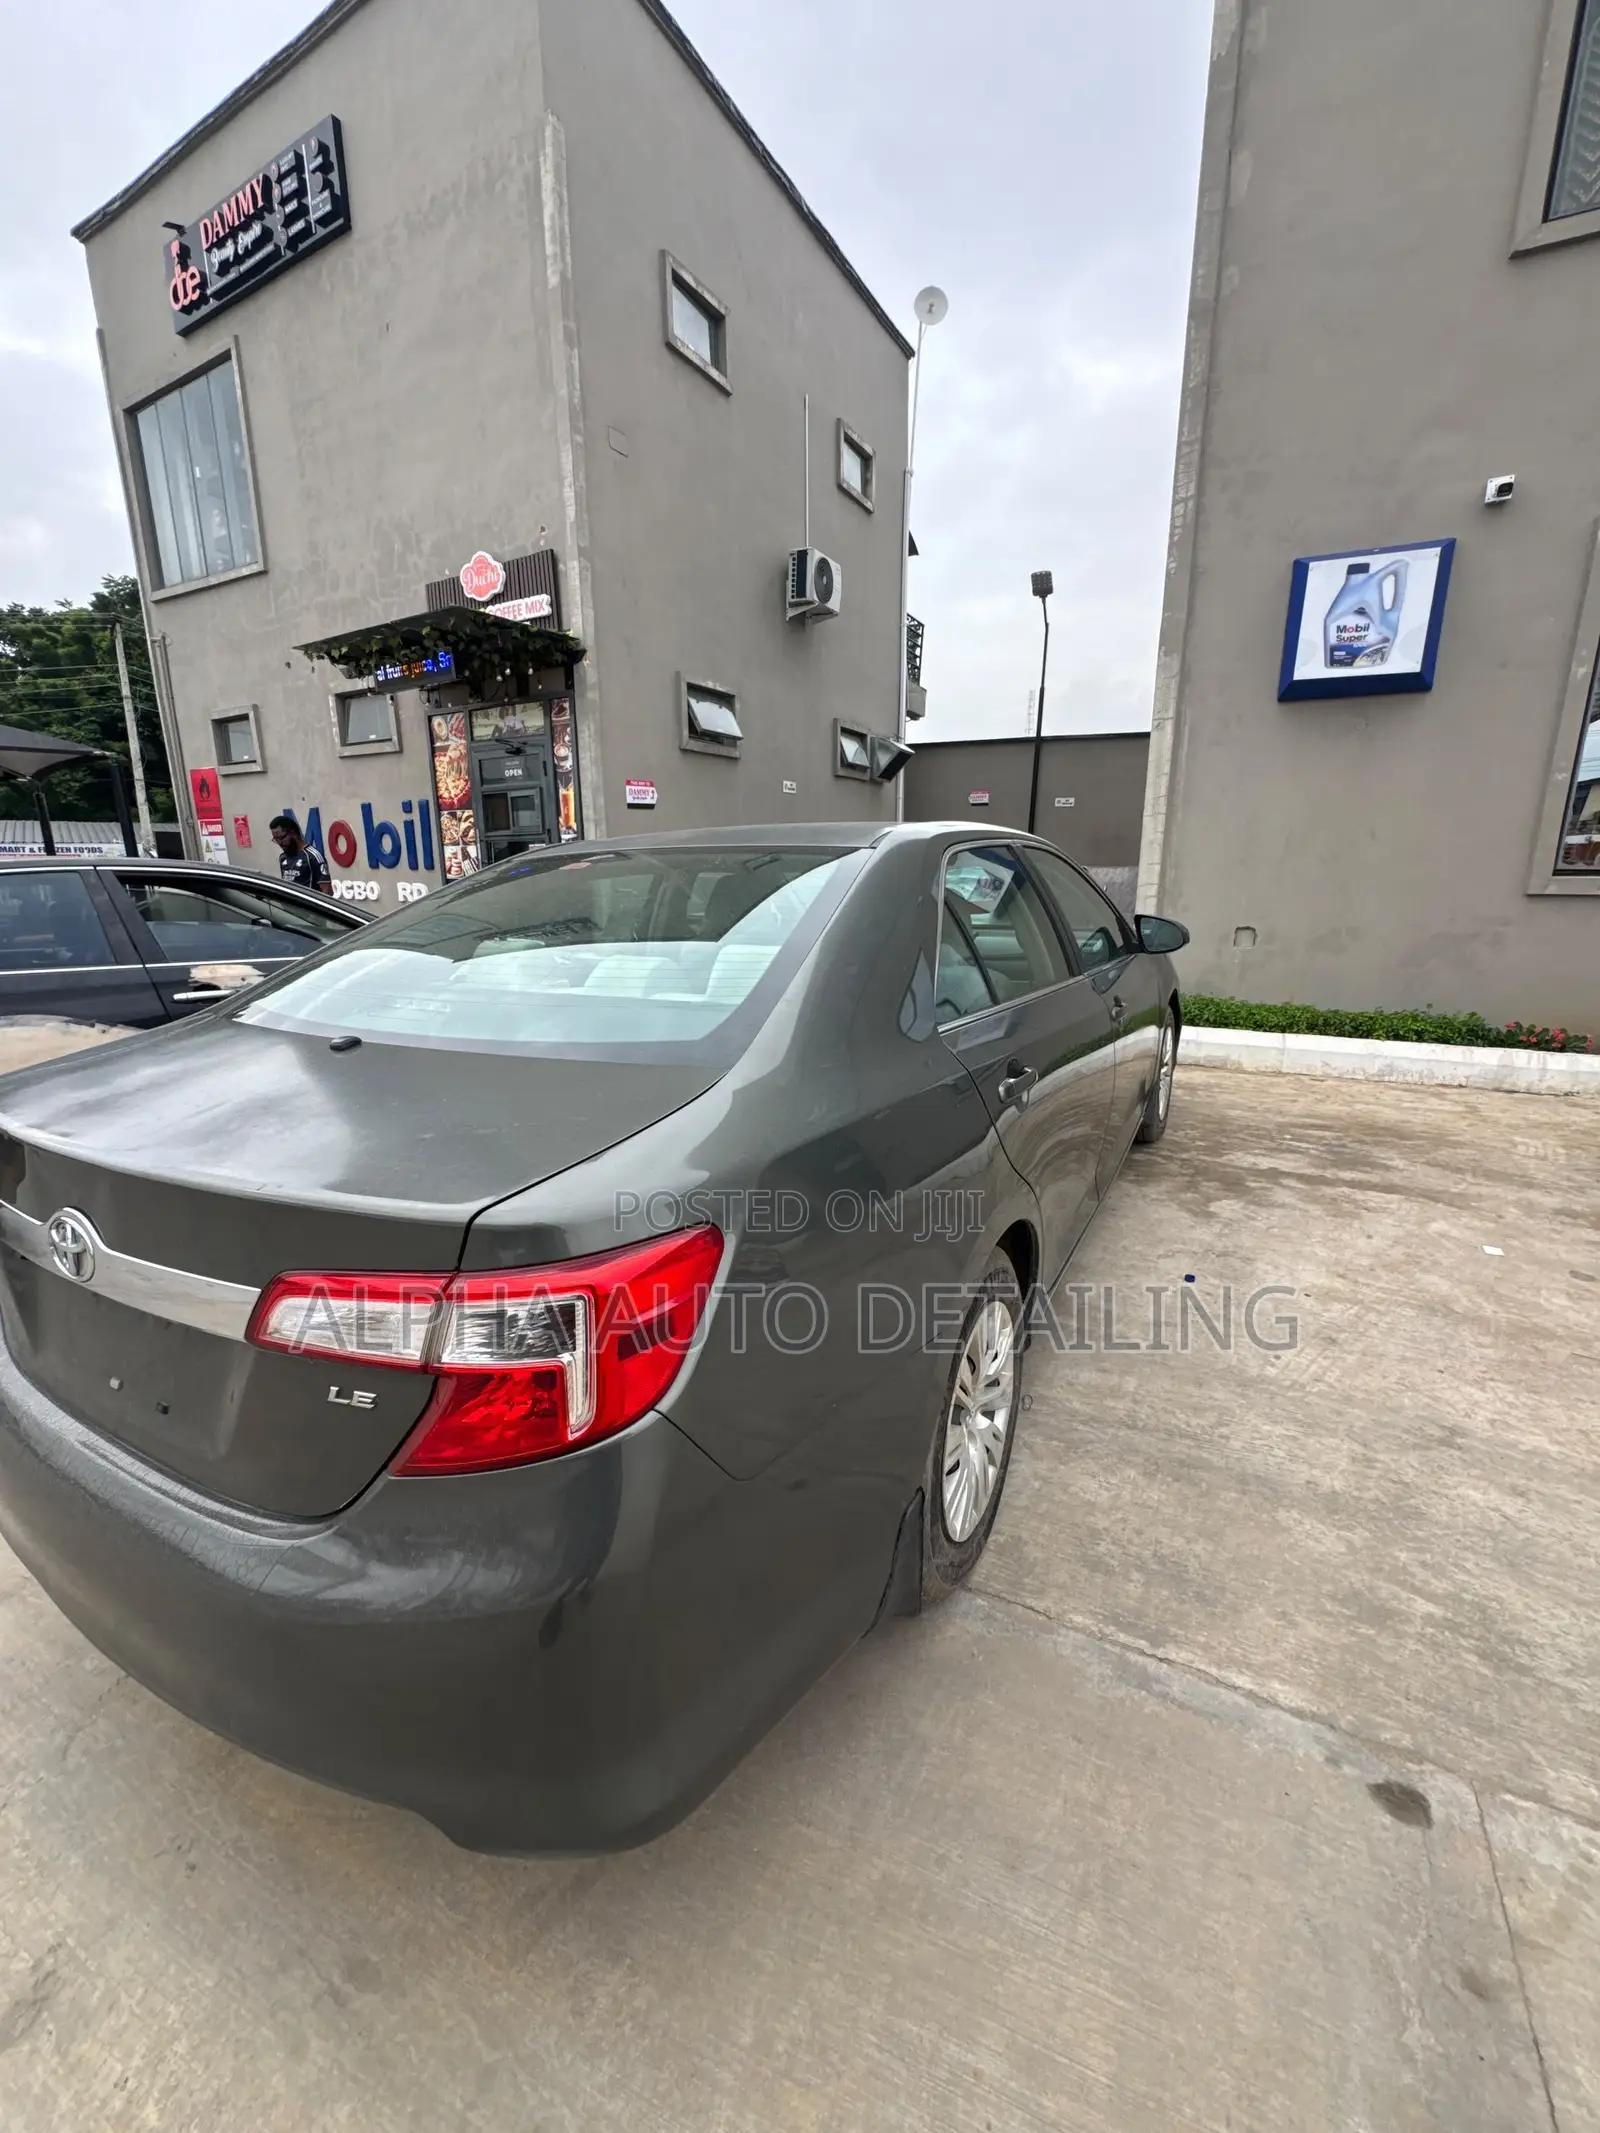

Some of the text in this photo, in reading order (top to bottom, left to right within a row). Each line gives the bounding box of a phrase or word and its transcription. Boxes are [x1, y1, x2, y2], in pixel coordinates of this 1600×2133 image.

[199, 173, 264, 250] DAMMY
[488, 600, 546, 619] OFFEE MIX
[1336, 623, 1370, 634] Mobil
[1336, 634, 1368, 642] Super
[386, 662, 409, 679] fruits
[504, 768, 523, 777] OPEN
[397, 882, 429, 902] RD
[327, 1386, 378, 1409] LE
